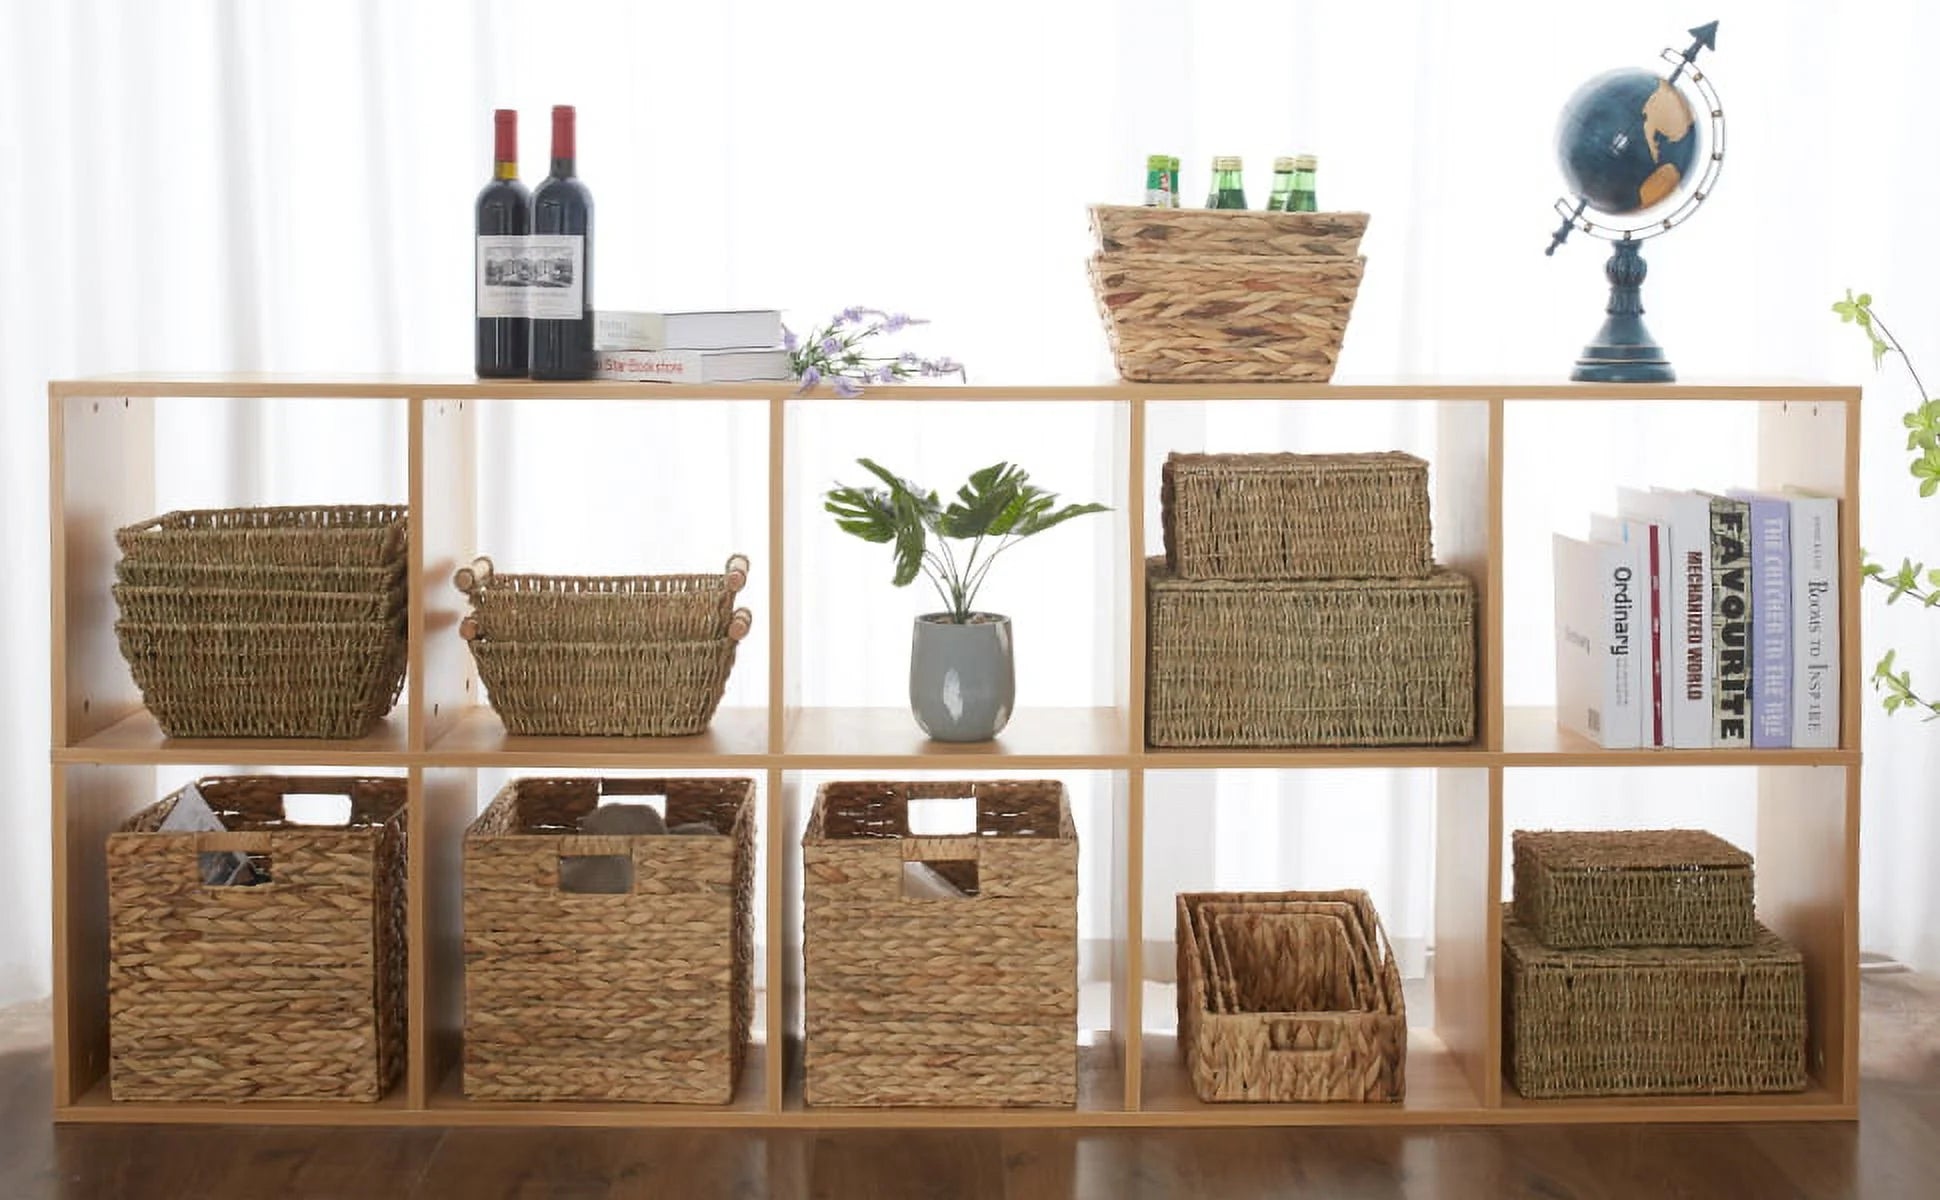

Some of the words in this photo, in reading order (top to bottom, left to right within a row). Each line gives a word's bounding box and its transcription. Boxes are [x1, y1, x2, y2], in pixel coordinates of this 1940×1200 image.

[1611, 566, 1633, 656] Ordinary
[1687, 551, 1703, 644] MECHANIZED
[1719, 512, 1746, 739] FAVOURITE
[1687, 647, 1703, 700] WORLD
